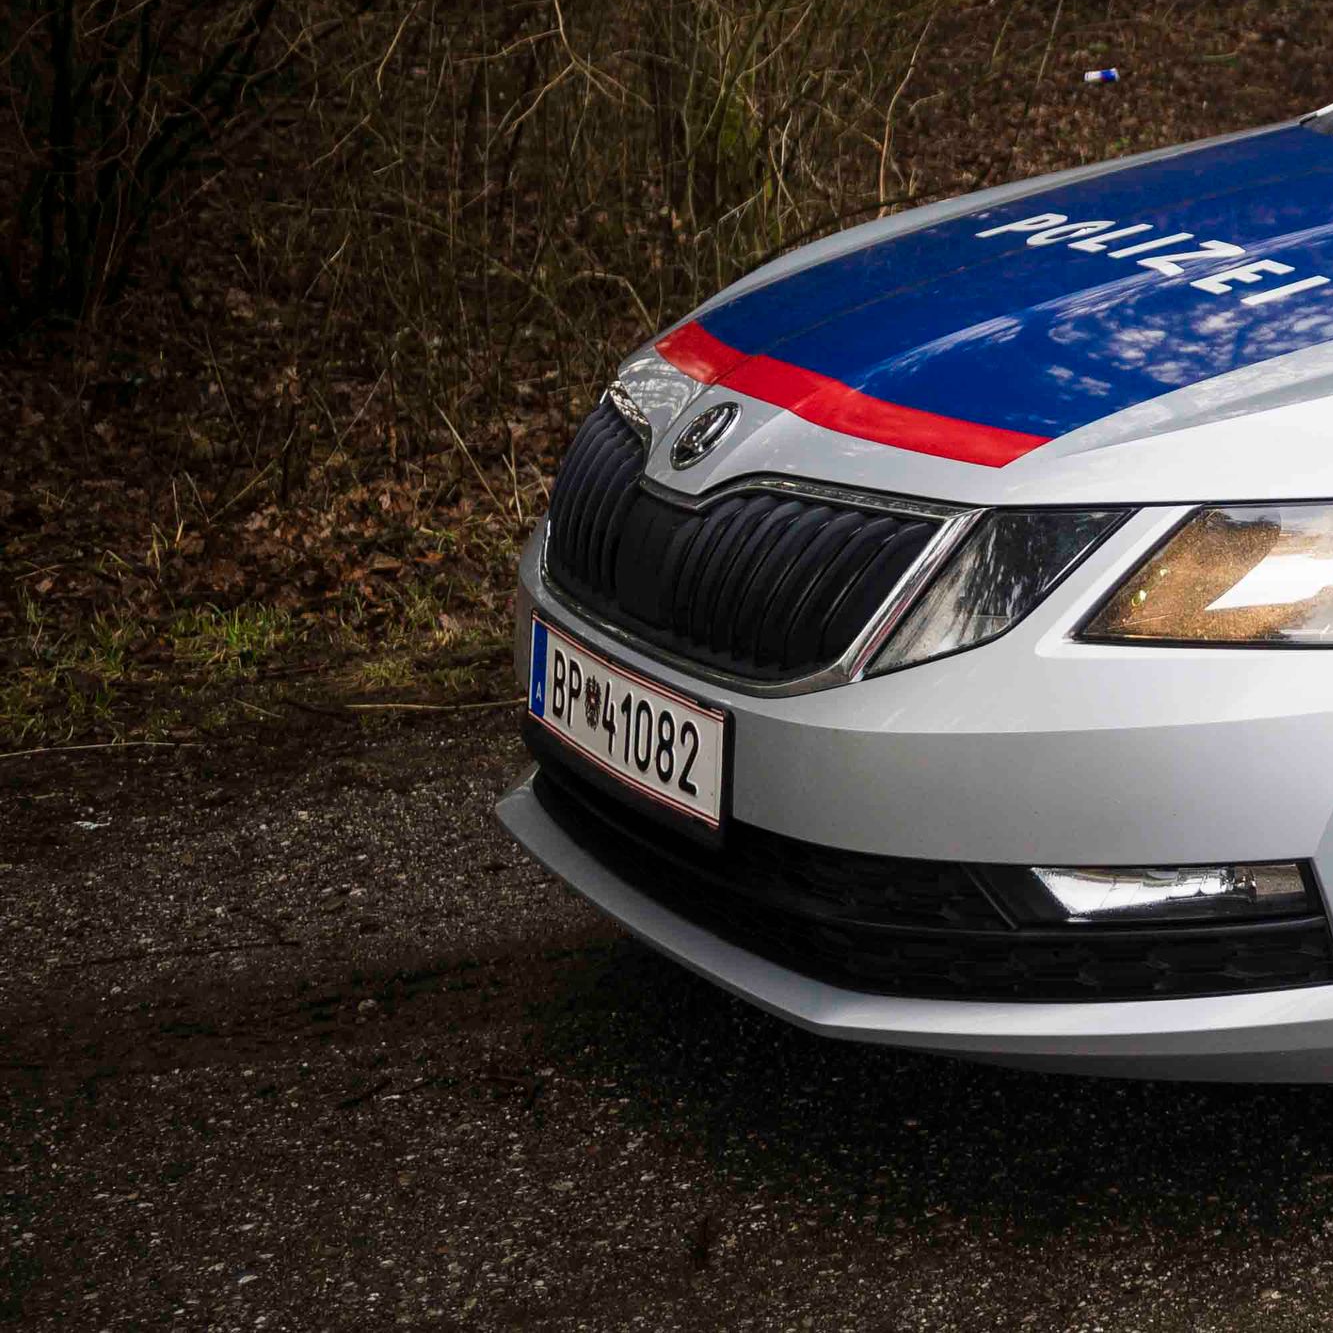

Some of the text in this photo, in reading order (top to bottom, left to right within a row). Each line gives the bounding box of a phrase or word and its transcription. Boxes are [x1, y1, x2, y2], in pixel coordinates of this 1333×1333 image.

[975, 212, 1331, 306] POLIZEI
[535, 682, 543, 703] A
[552, 649, 700, 797] BP 41082
